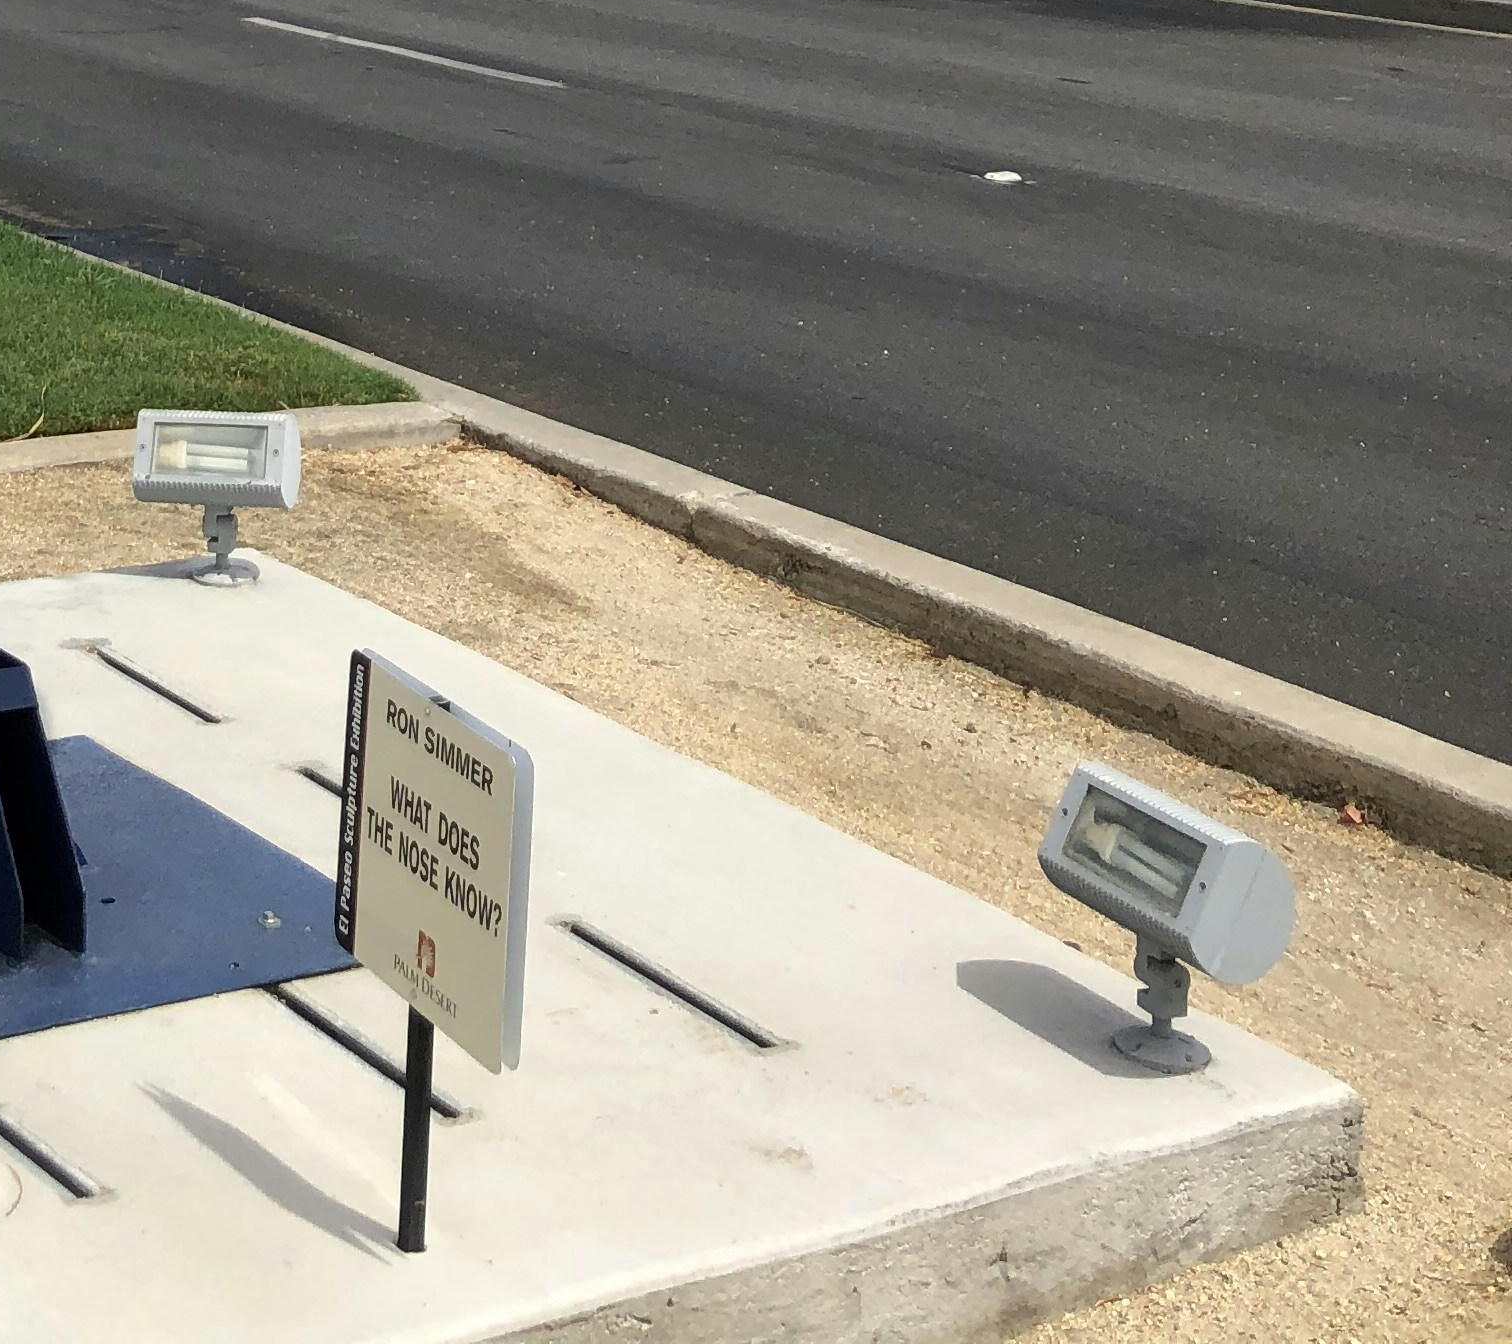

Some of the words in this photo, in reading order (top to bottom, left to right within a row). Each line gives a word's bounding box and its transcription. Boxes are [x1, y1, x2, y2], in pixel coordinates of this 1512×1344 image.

[349, 663, 366, 751] Exhibition
[386, 698, 420, 746] RON
[423, 726, 494, 796] SIMMER
[343, 754, 361, 848] Sculpture
[390, 775, 433, 834] WHAT
[437, 812, 480, 871] DOES
[340, 850, 354, 914] Paseo
[366, 806, 394, 856] THE
[397, 834, 439, 890] NOSE
[444, 865, 503, 937] KNOW?
[339, 916, 351, 935] El
[393, 952, 421, 993] PALM
[421, 978, 458, 1019] DESERT
